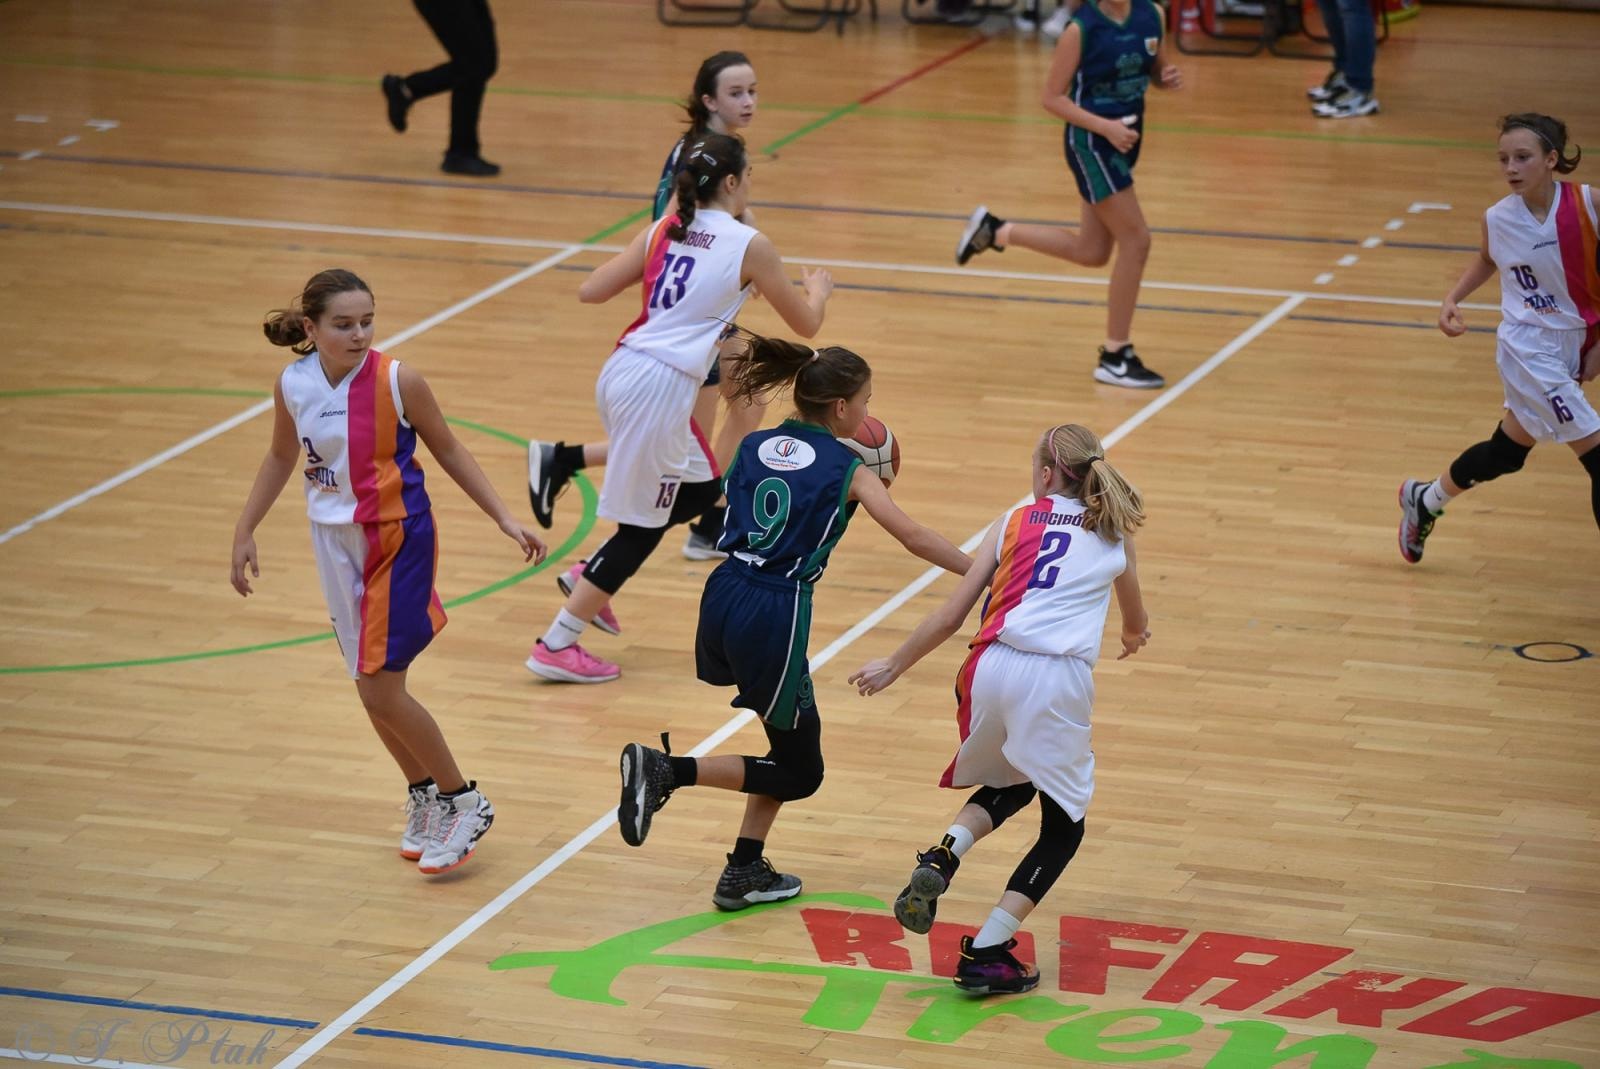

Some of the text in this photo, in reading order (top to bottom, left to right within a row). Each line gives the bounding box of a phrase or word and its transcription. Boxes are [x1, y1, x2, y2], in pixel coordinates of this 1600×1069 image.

[650, 253, 696, 310] 13
[1510, 264, 1538, 291] 16
[655, 482, 677, 509] 13
[748, 477, 791, 550] 9
[1027, 531, 1072, 589] 2
